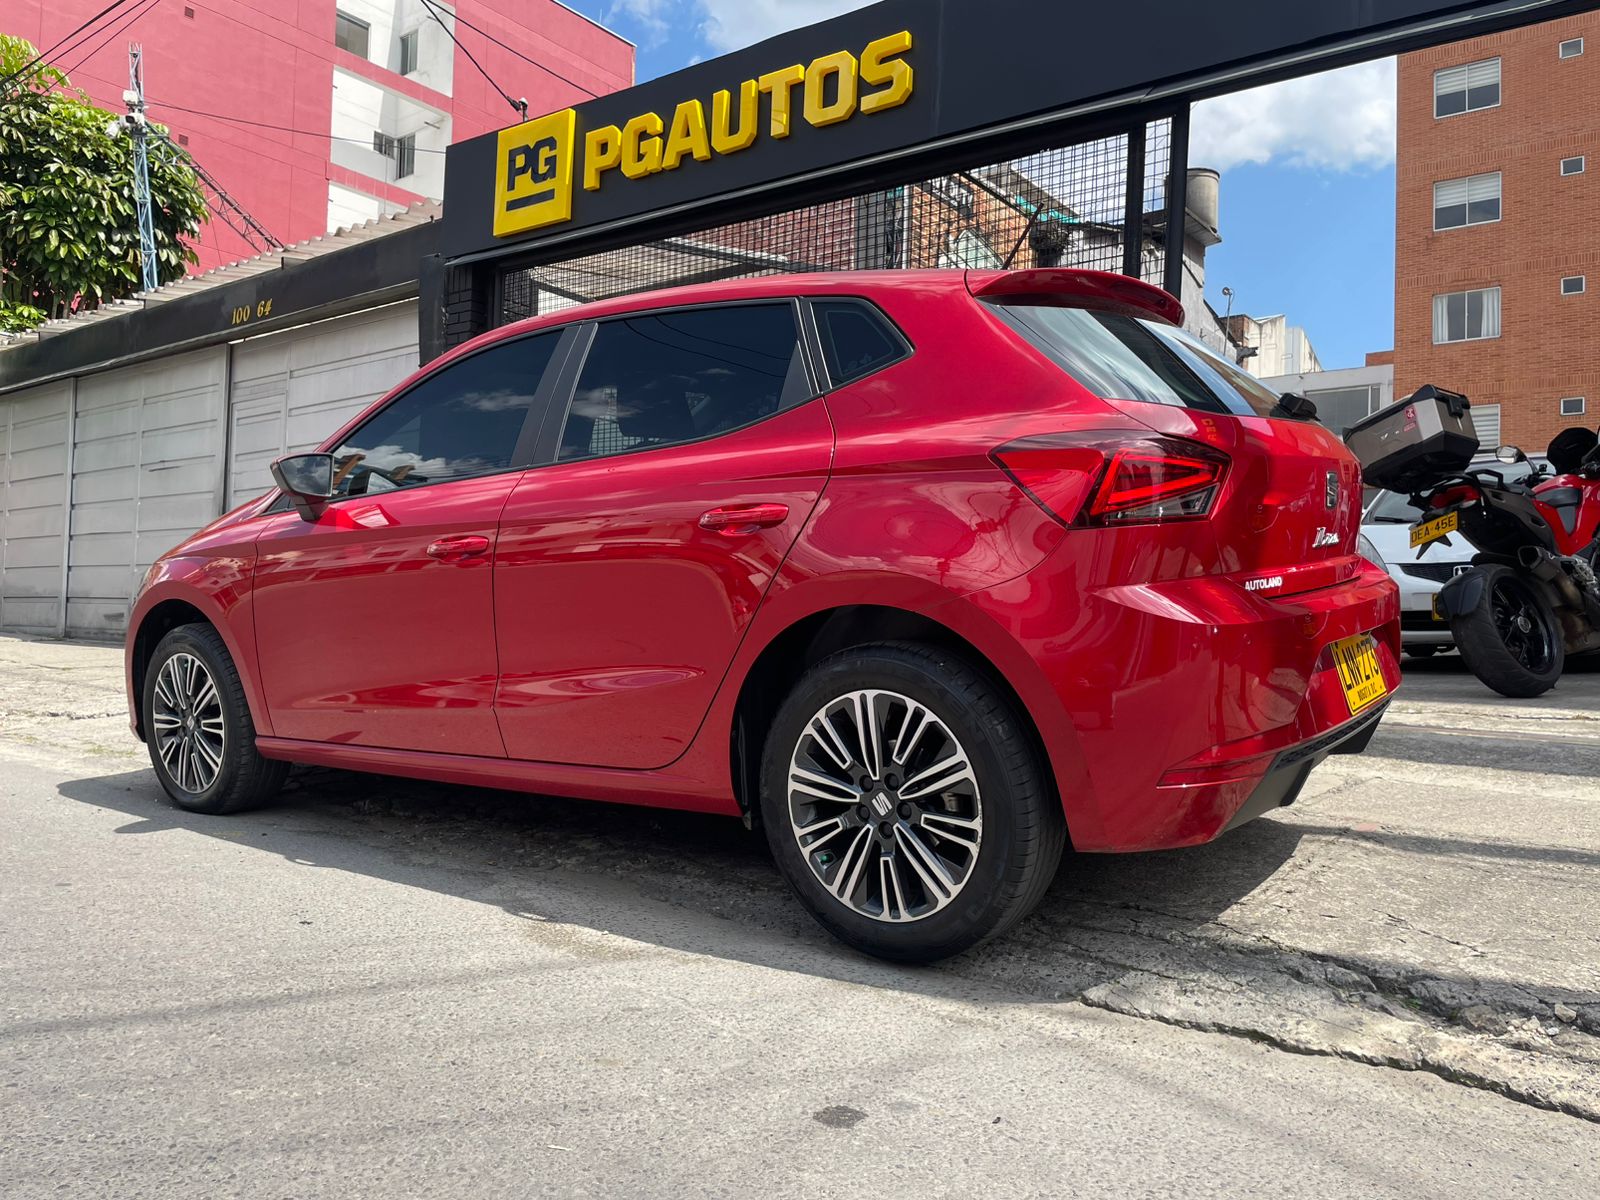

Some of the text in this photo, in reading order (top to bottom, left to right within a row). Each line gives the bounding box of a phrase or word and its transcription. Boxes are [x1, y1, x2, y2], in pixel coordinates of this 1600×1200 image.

[584, 30, 913, 191] PGAUTOS
[507, 136, 557, 192] PG
[232, 298, 272, 325] 100 64
[1244, 576, 1283, 591] AUTOLAND
